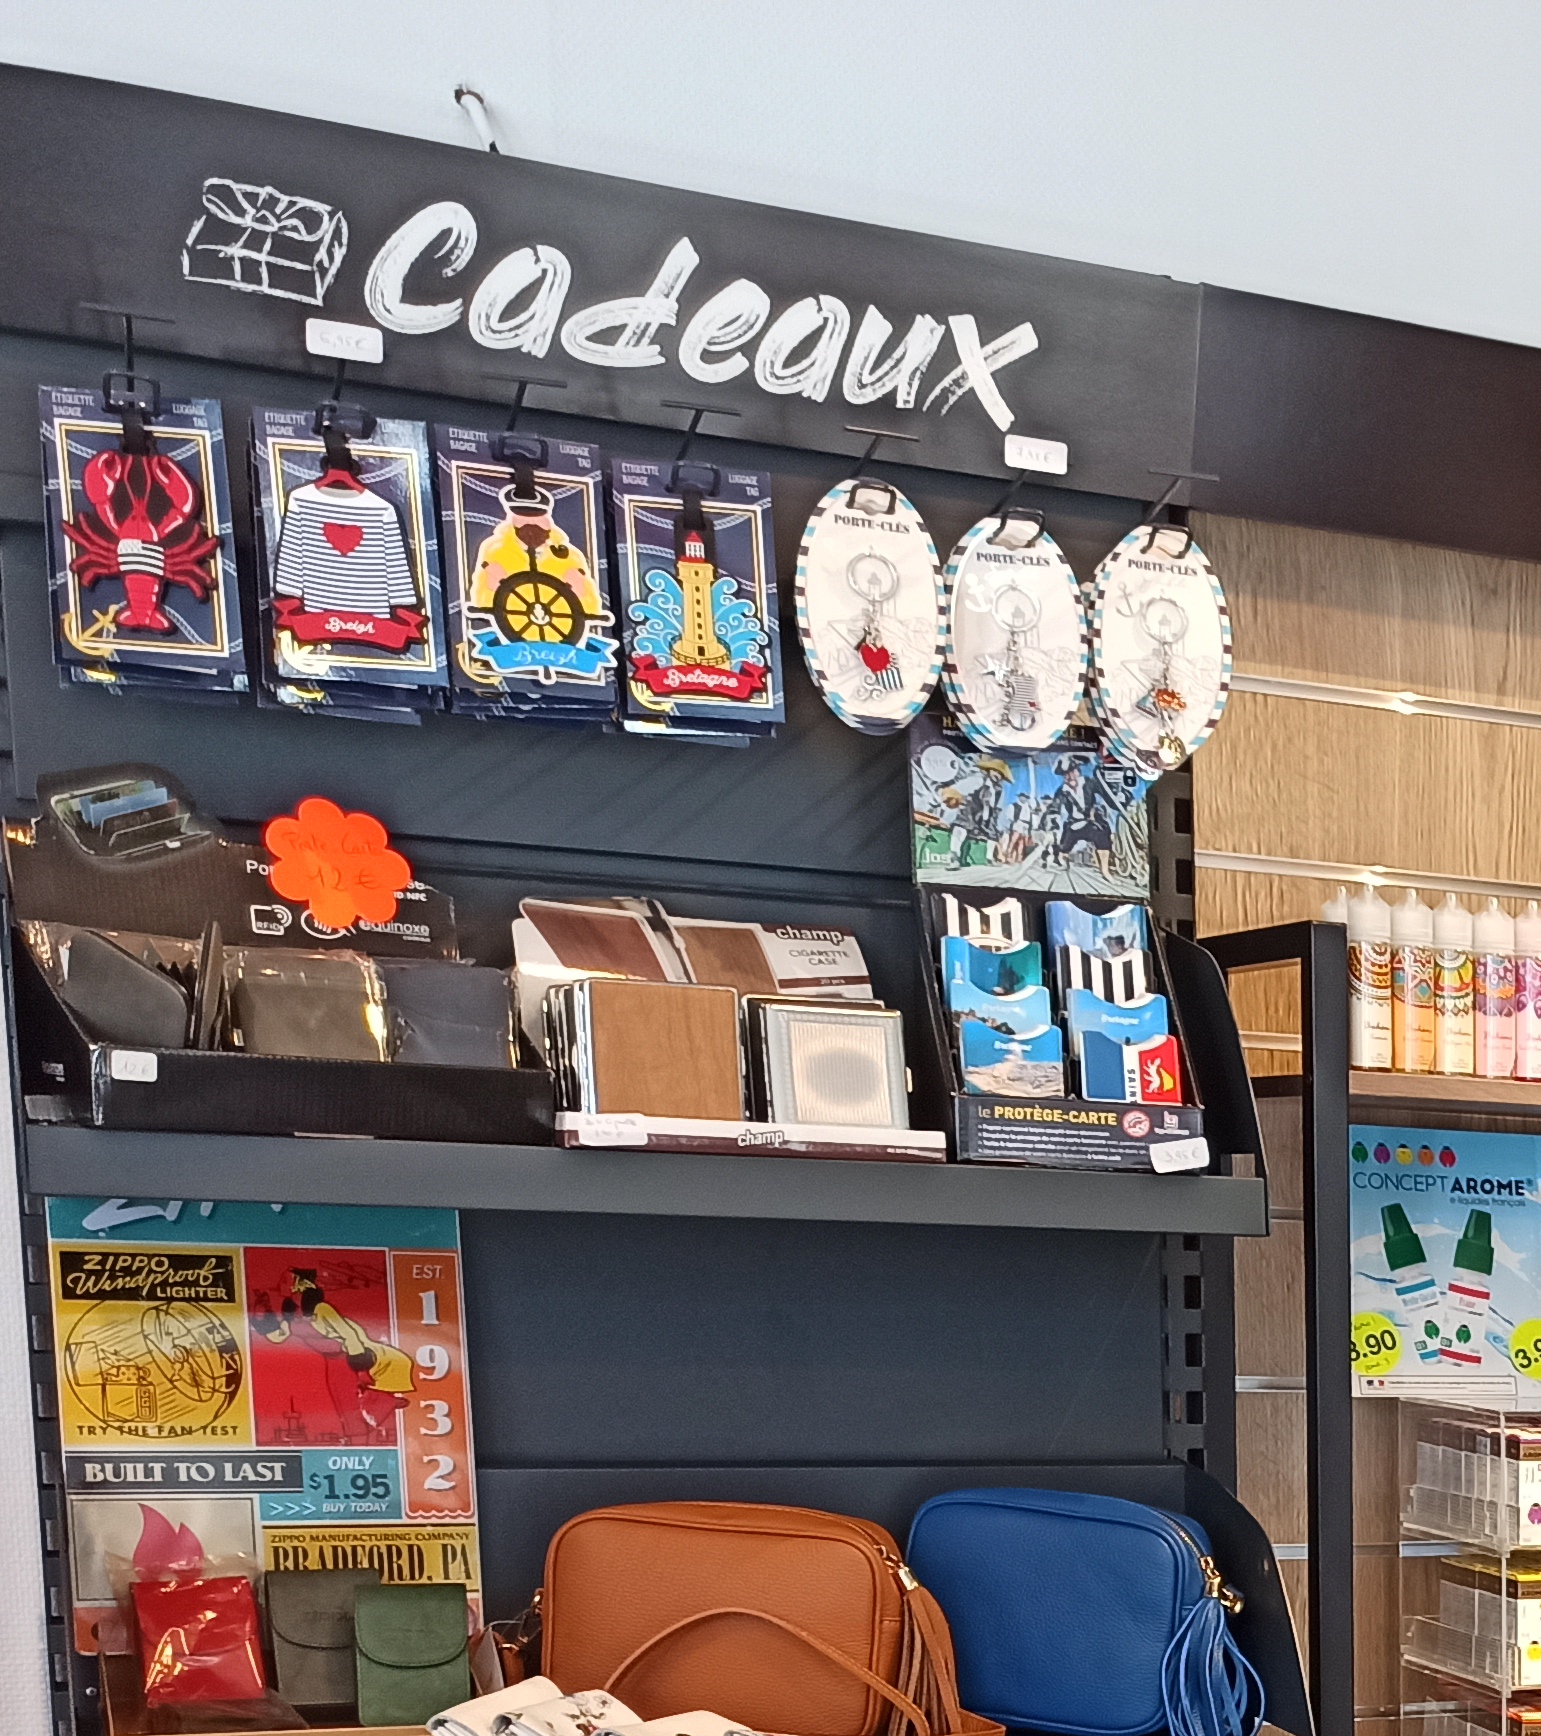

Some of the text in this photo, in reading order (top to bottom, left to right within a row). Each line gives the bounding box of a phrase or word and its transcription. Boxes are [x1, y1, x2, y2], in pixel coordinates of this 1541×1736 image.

[364, 200, 1041, 431] Cadeaux
[664, 668, 738, 688] Bretagne
[775, 923, 843, 945] champ
[994, 1104, 1117, 1126] PROTÈGE-CARTE
[737, 1130, 785, 1148] champ
[84, 1254, 169, 1271] ZIPPO
[67, 1257, 226, 1295] Windproof
[157, 1285, 227, 1300] LIGHTER
[77, 1425, 238, 1437] TRY THE FAN TEST
[86, 1462, 286, 1483] BUILT TO LAST
[328, 1456, 374, 1470] ONLY
[309, 1473, 390, 1500] $1.95
[322, 1501, 389, 1513] BUY TODAY
[271, 1532, 470, 1543] ZIPPO MANUFACTURING COMPANY
